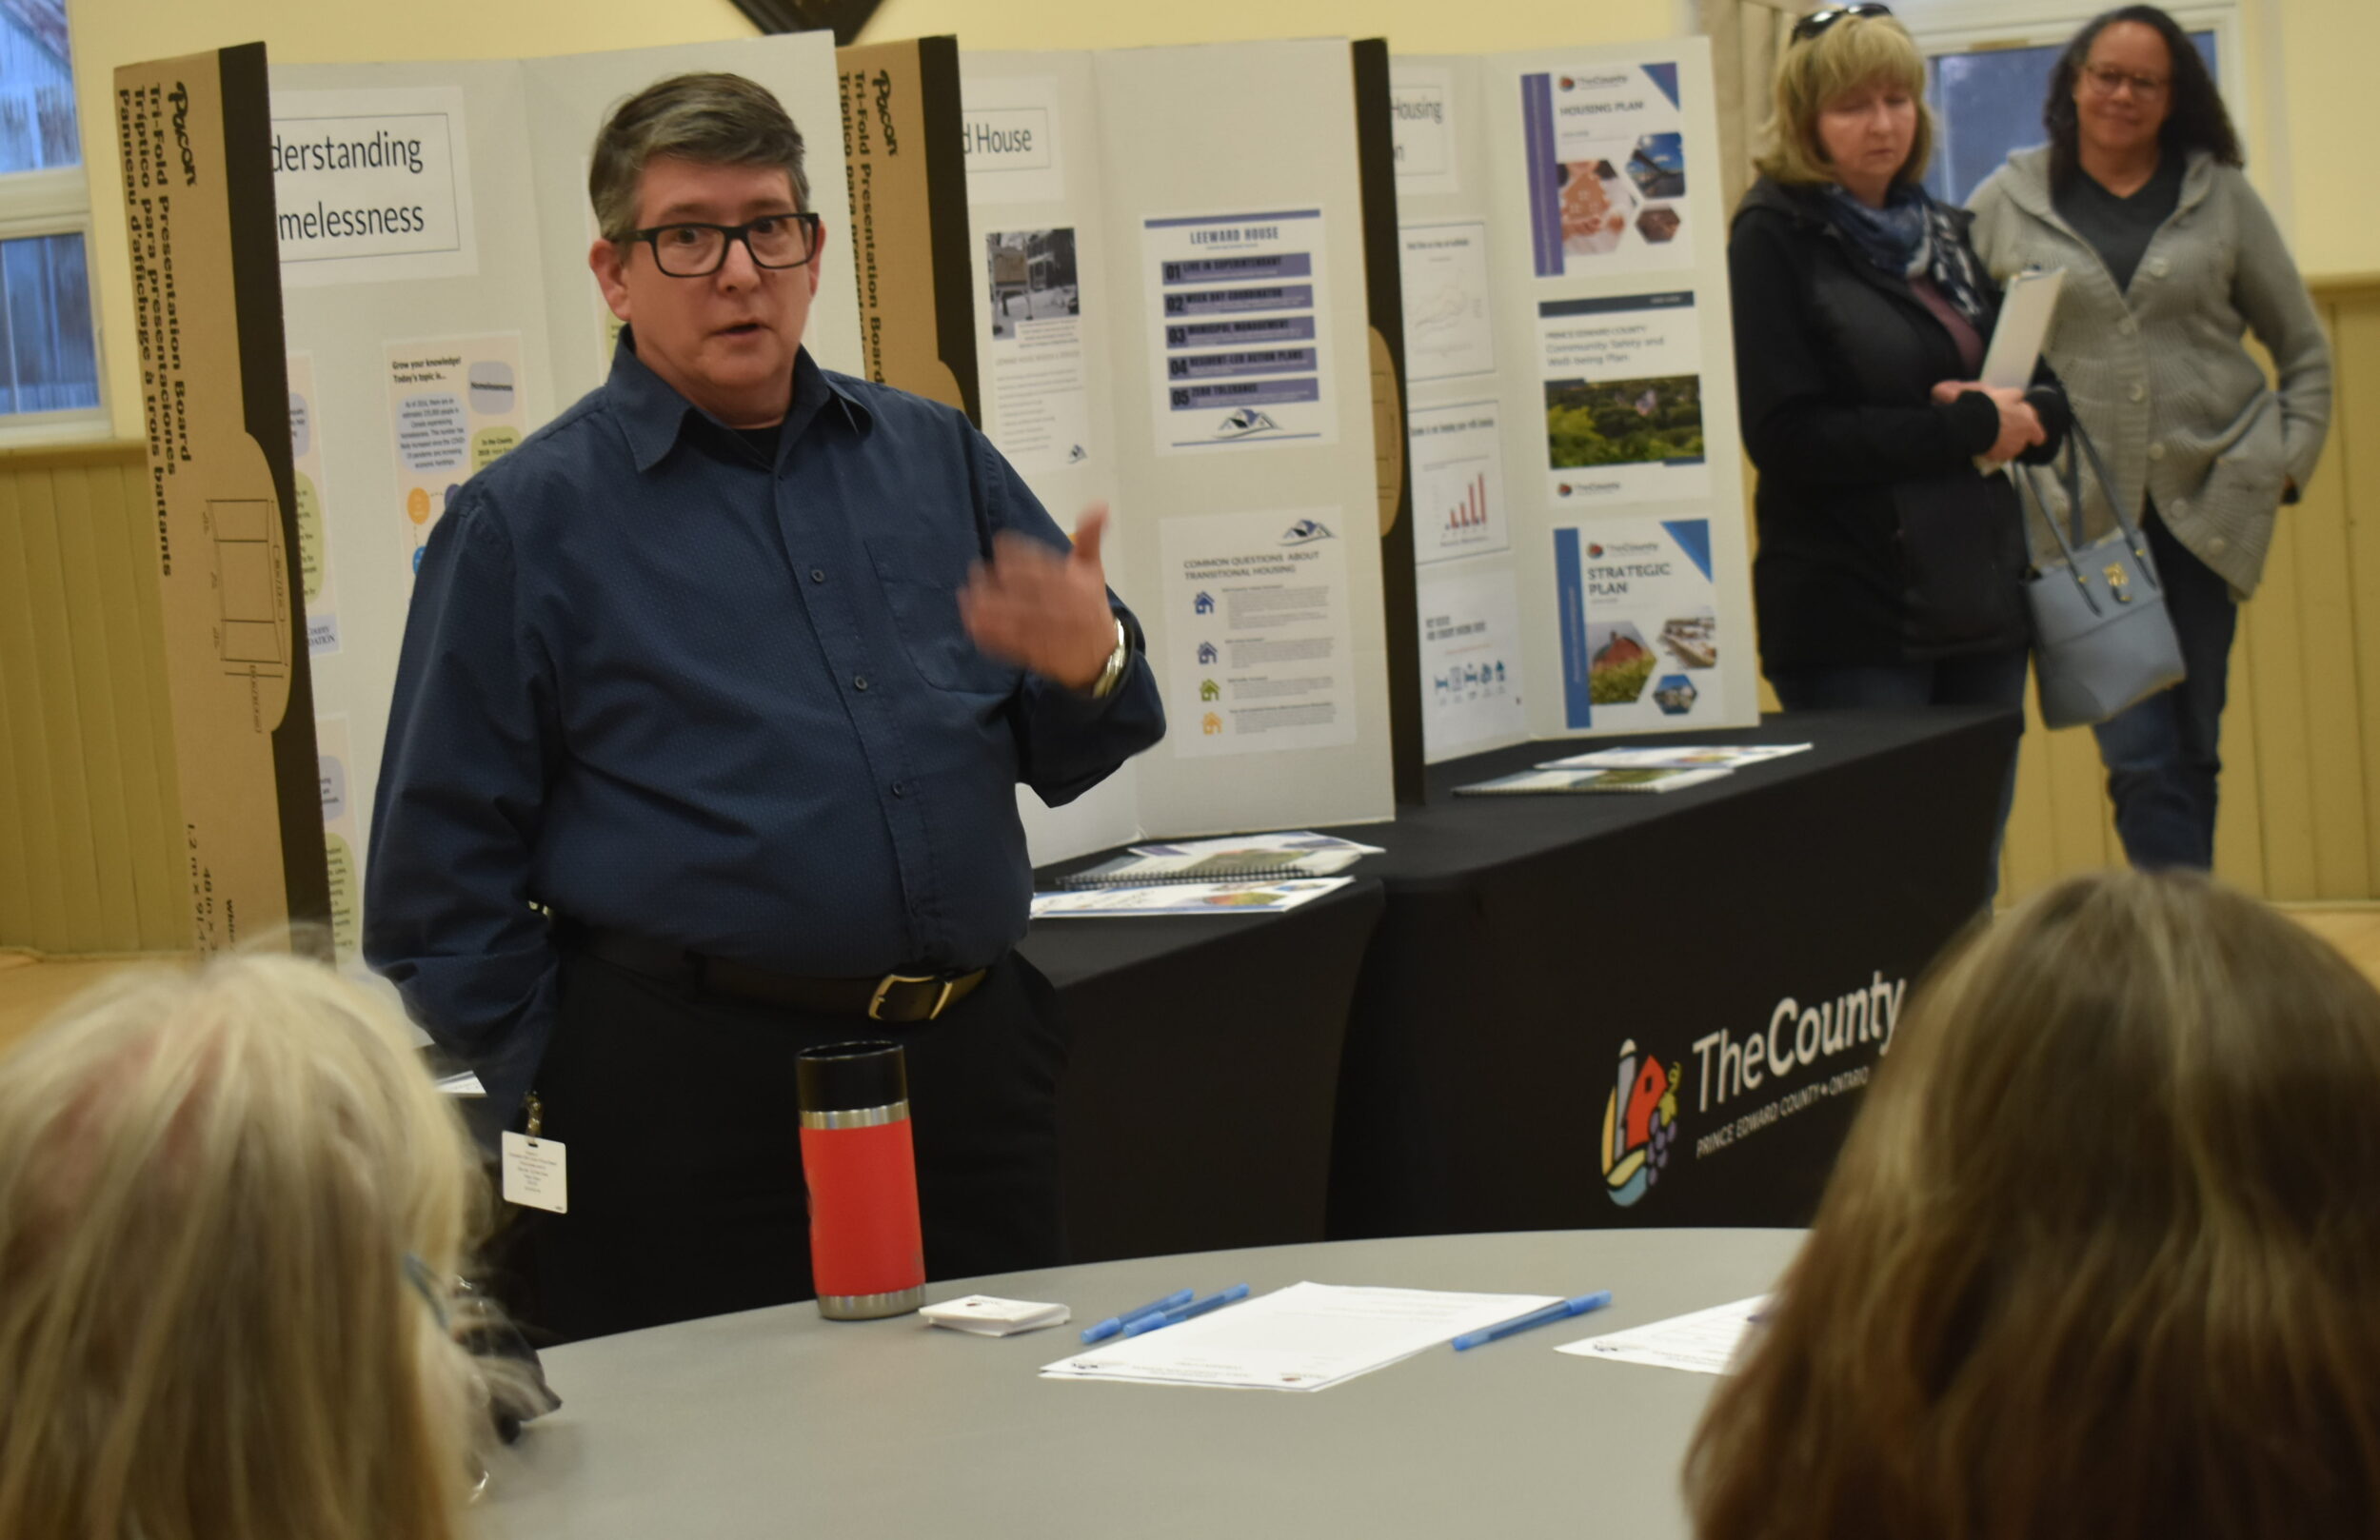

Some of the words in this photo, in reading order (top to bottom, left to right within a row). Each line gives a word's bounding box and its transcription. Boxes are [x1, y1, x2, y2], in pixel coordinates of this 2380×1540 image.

[150, 83, 169, 186] Tri-Fold
[168, 81, 197, 186] Pacon
[855, 70, 871, 155] Tri-Fold
[872, 69, 899, 157] Pacon
[976, 123, 1032, 154] House
[141, 198, 156, 259] para
[861, 163, 879, 308] Presentation
[1190, 229, 1240, 245] LEEWARD
[1244, 227, 1279, 241] HOUSE
[158, 195, 181, 370] Presentation
[1166, 265, 1180, 281] 01
[119, 89, 137, 206] Panneau
[130, 215, 152, 362] d'affichage
[147, 394, 161, 457] trois
[154, 466, 171, 577] battants
[1166, 296, 1183, 312] 02
[147, 268, 176, 475] presentaciones
[392, 360, 409, 369] Grow
[410, 359, 425, 370] your
[393, 373, 418, 385] Today's
[419, 372, 435, 383] topic
[870, 317, 885, 384] Board
[1170, 359, 1187, 375] 04
[175, 381, 191, 462] Board
[1172, 389, 1190, 406] 05
[1183, 558, 1229, 569] COMMON
[1231, 554, 1283, 567] QUESTIONS
[1287, 550, 1319, 563] ABOUT
[1184, 567, 1250, 581] TRANSITIONAL
[1253, 564, 1297, 577] HOUSING
[1588, 563, 1672, 580] STRATEGIC
[1588, 582, 1628, 596] PLAN
[1692, 970, 1907, 1113] TheCounty
[1696, 1123, 1735, 1159] PRINCE
[1736, 1101, 1779, 1139] EDWARD
[1780, 1082, 1821, 1117] COUNTY
[1829, 1065, 1870, 1096] ONTARIO
